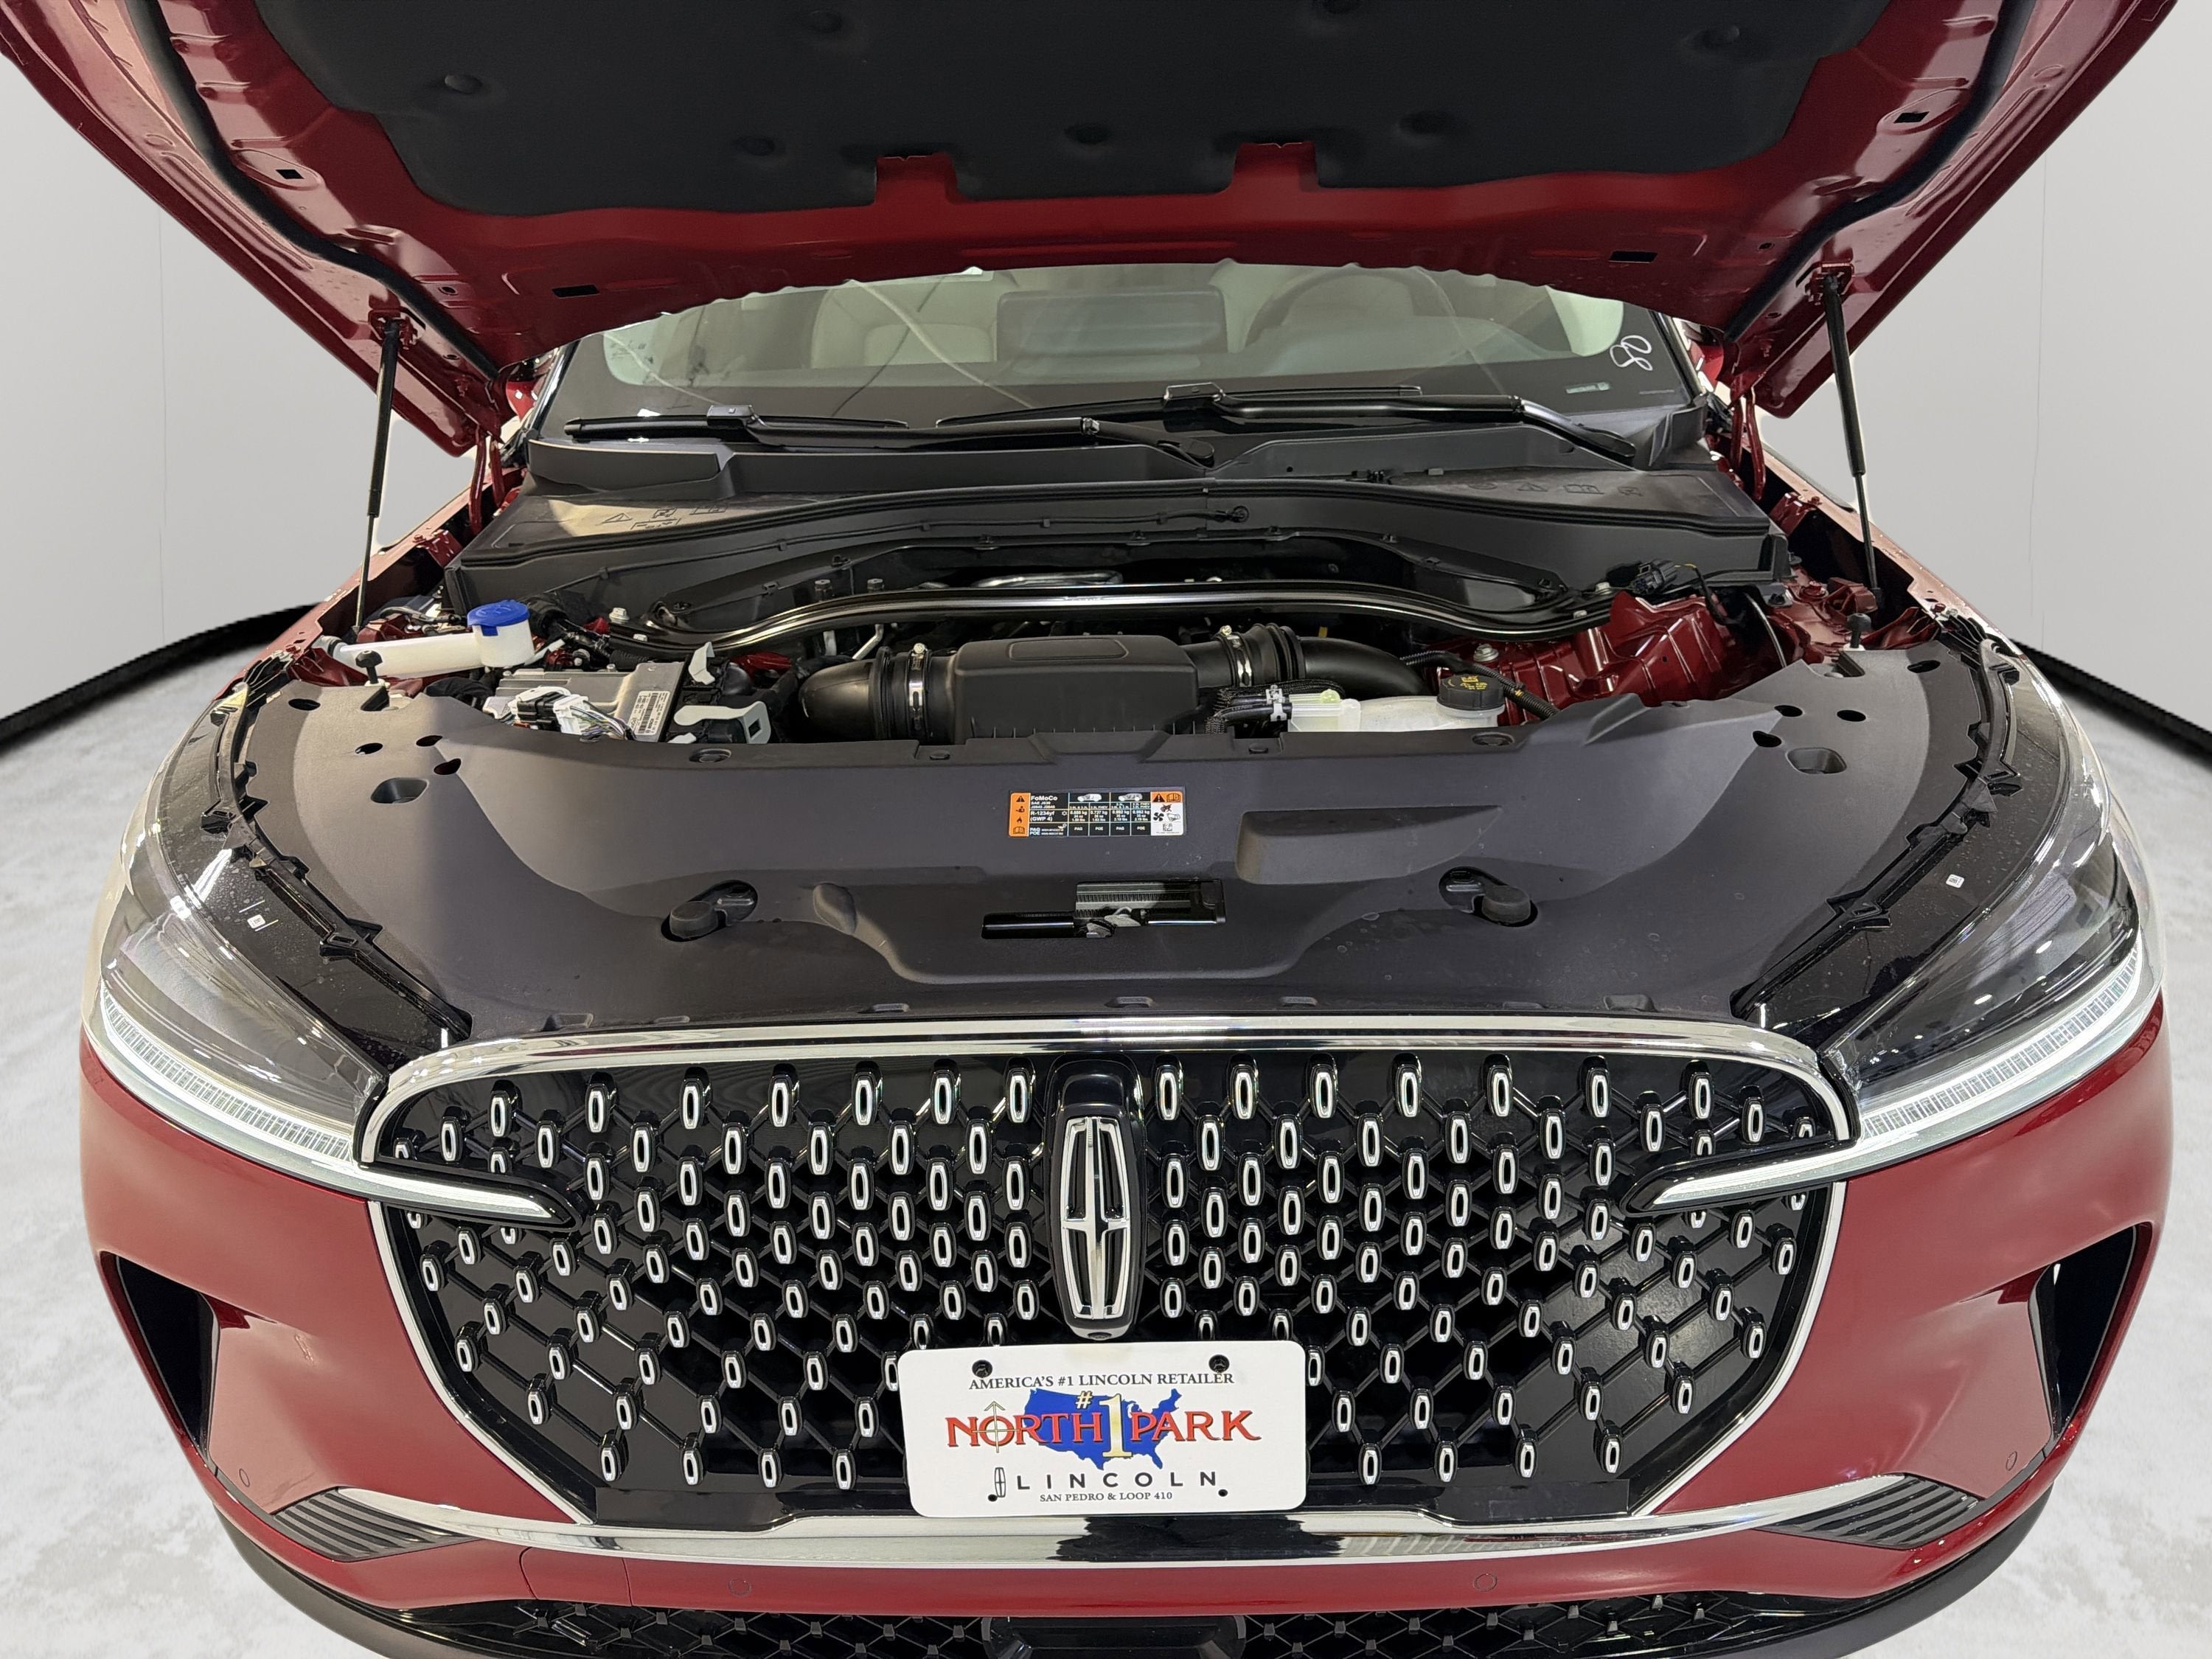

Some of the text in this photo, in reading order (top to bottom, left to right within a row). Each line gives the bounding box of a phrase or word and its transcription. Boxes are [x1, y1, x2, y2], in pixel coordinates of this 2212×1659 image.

[968, 1372, 1234, 1390] AMERICA'S #1 LINCOLN RETAILER
[945, 1410, 1262, 1448] NORTH PARK
[1016, 1471, 1217, 1490] LINCOLN
[1040, 1492, 1173, 1502] SAN PEDRO & LOOP 410
